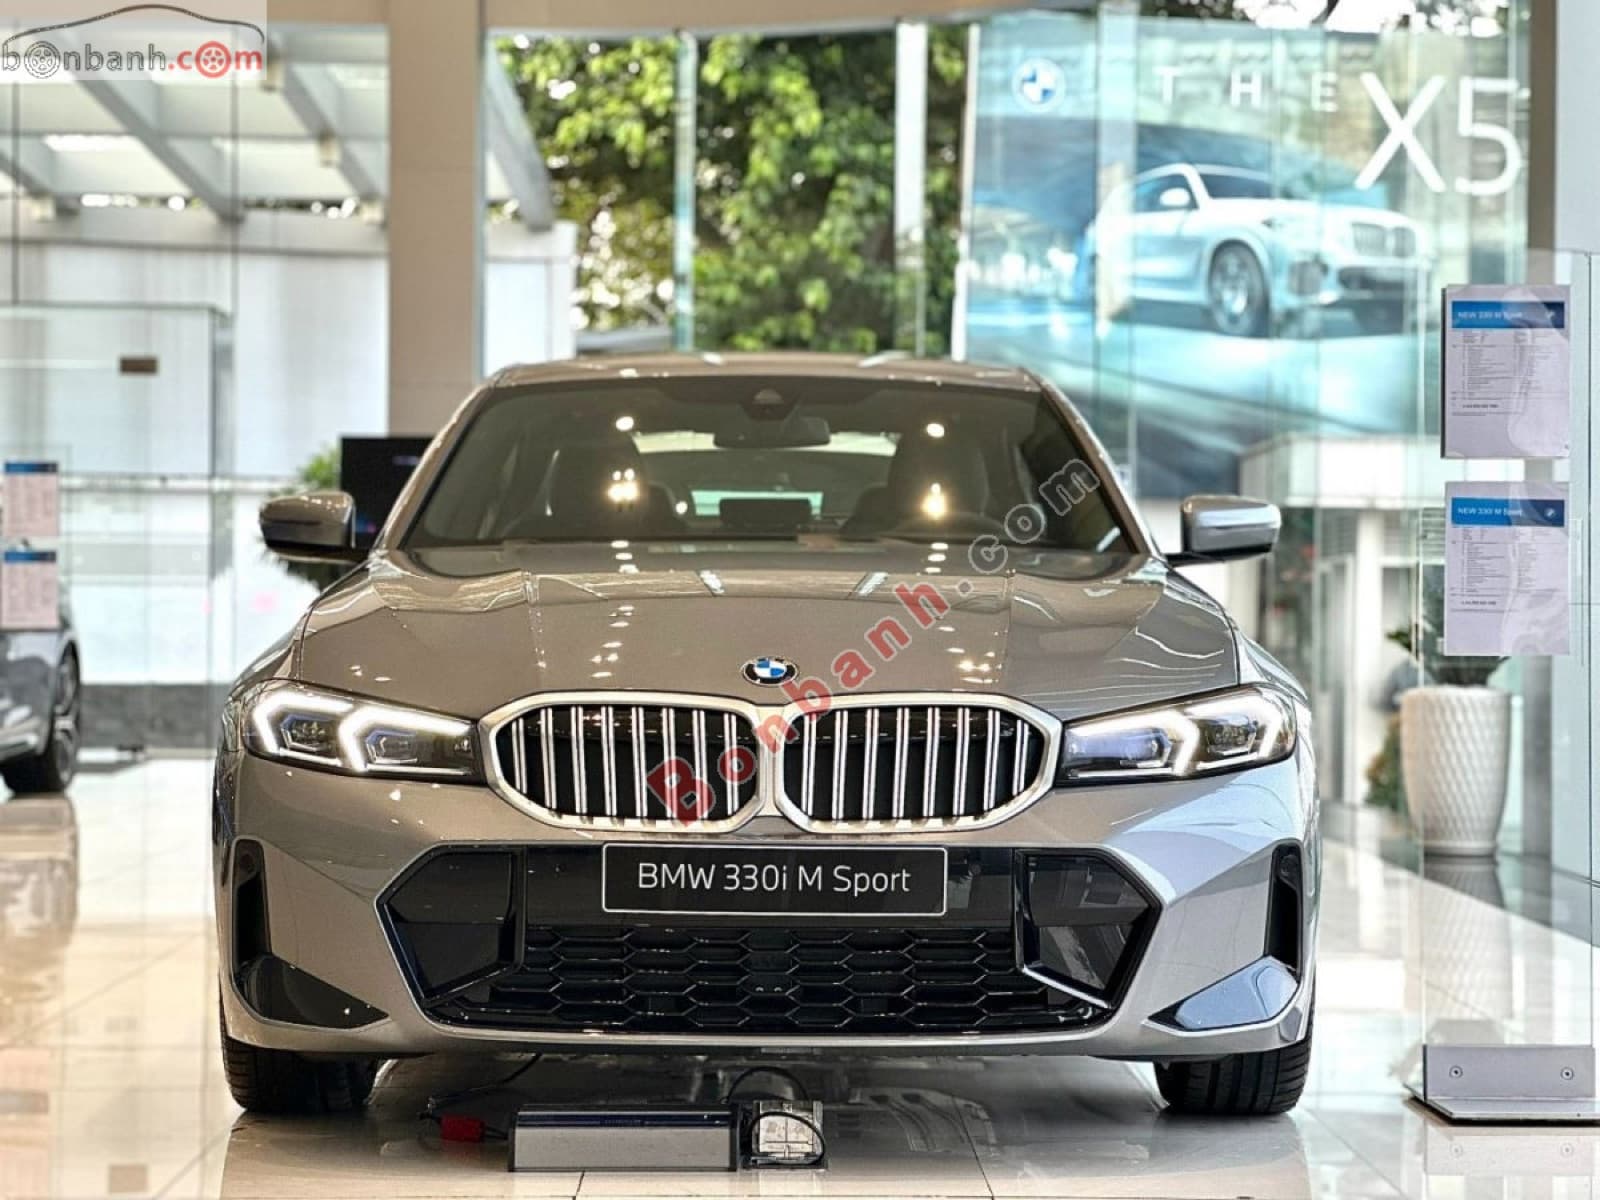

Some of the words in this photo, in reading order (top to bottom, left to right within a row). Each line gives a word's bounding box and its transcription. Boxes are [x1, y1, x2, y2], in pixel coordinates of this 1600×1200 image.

[1156, 66, 1339, 112] THE
[1355, 71, 1523, 196] X5
[638, 862, 716, 890] BMW
[723, 863, 788, 891] 330i
[798, 864, 822, 891] M
[833, 865, 912, 897] Sport
